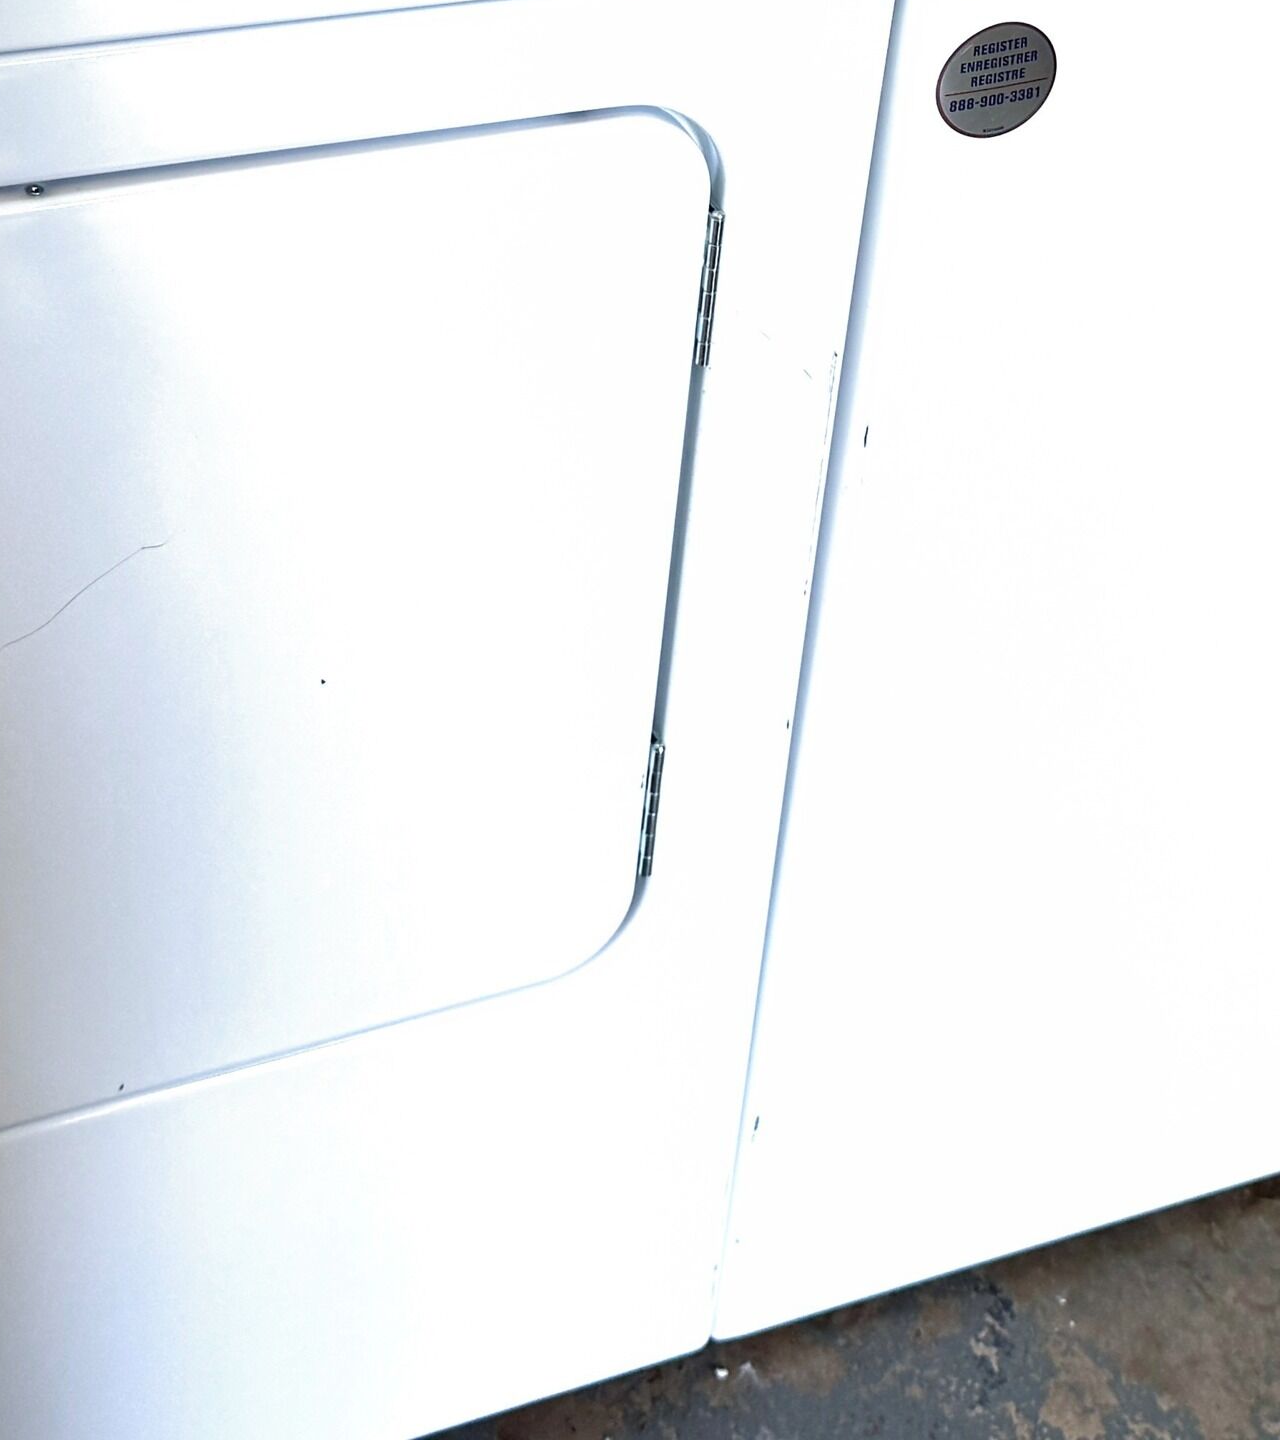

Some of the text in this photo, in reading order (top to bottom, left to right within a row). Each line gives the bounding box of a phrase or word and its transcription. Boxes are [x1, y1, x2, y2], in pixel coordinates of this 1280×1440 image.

[974, 37, 1028, 56] REGISTER
[960, 50, 1038, 73] ENREGISTRER
[971, 67, 1026, 87] REGISTRE
[950, 86, 1040, 112] 888-900-3381
